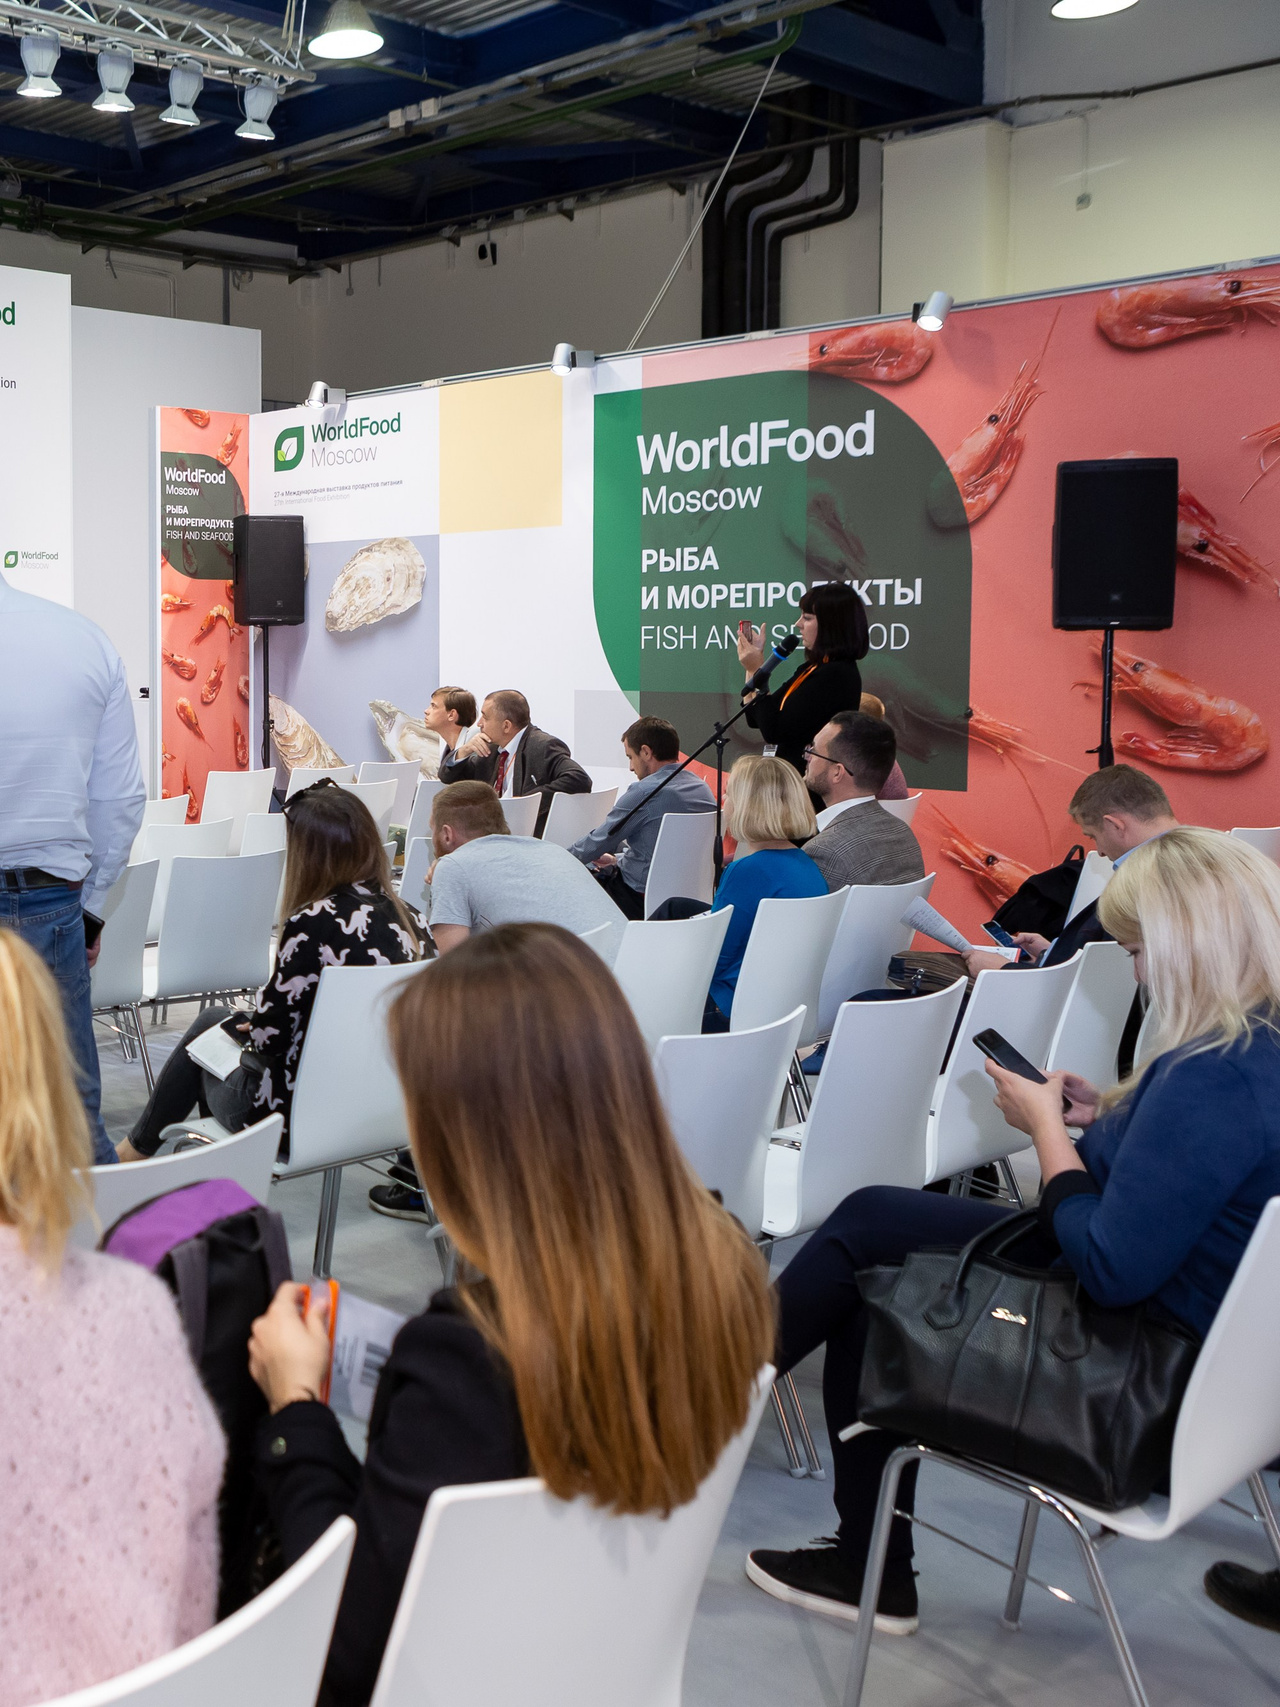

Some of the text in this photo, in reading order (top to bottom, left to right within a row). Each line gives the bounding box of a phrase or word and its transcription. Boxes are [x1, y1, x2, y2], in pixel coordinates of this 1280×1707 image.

[312, 412, 402, 443] WorldFood
[635, 408, 875, 475] WorldFood
[311, 446, 378, 468] Moscow
[164, 466, 226, 484] WorldFood
[166, 484, 200, 496] Moscow
[641, 485, 763, 515] Moscow
[166, 505, 189, 514] РЫБА
[166, 517, 172, 526] И
[166, 530, 183, 540] FISH
[184, 531, 200, 540] AND
[21, 551, 59, 560] WorldFood
[641, 546, 719, 573] РЫБА
[641, 578, 922, 610] И МОРЕПРОКТЫ
[641, 625, 696, 650] FISH
